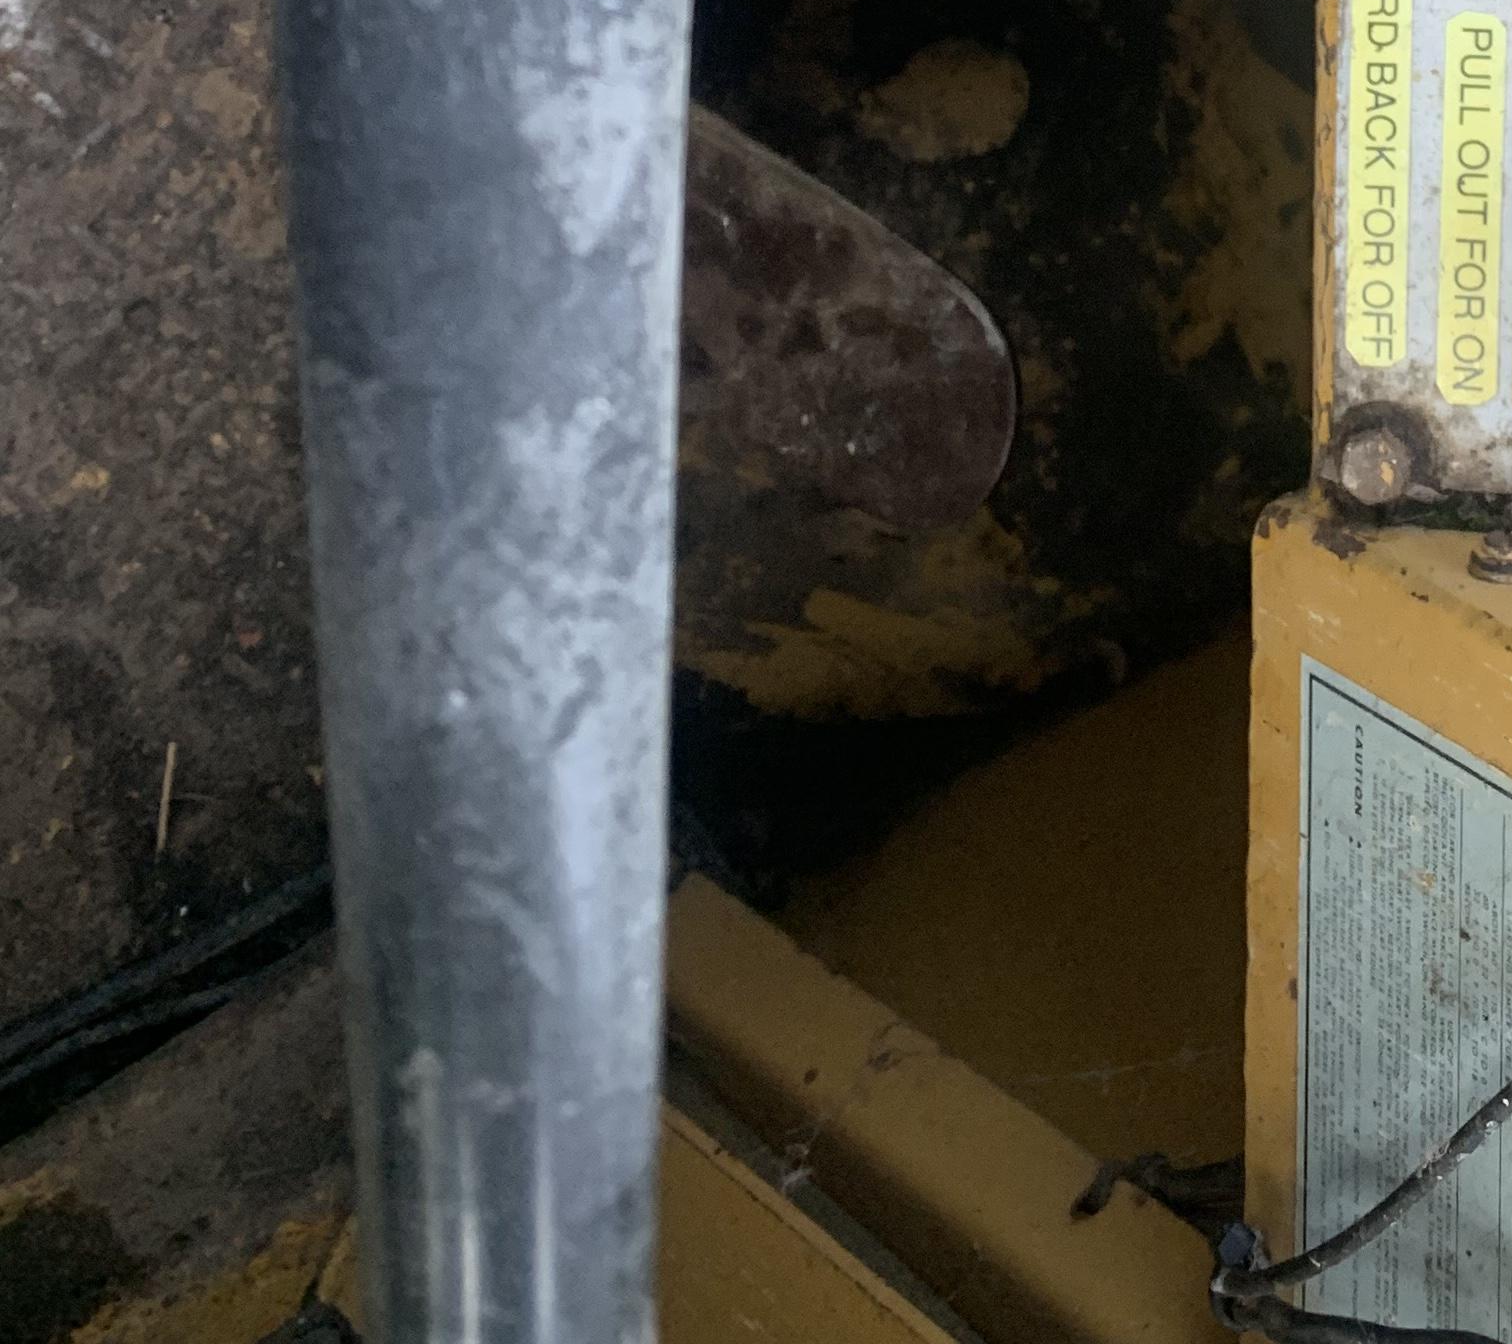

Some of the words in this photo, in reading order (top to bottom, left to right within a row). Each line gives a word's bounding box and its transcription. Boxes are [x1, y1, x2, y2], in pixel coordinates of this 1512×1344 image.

[1363, 62, 1400, 170] BACK
[1457, 26, 1494, 126] PULL
[1455, 138, 1491, 226] OUT
[1362, 183, 1398, 269] FOR
[1360, 279, 1396, 362] OFF
[1453, 238, 1487, 321] FOR
[1451, 333, 1486, 393] ON
[1354, 723, 1364, 817] CAUTION
